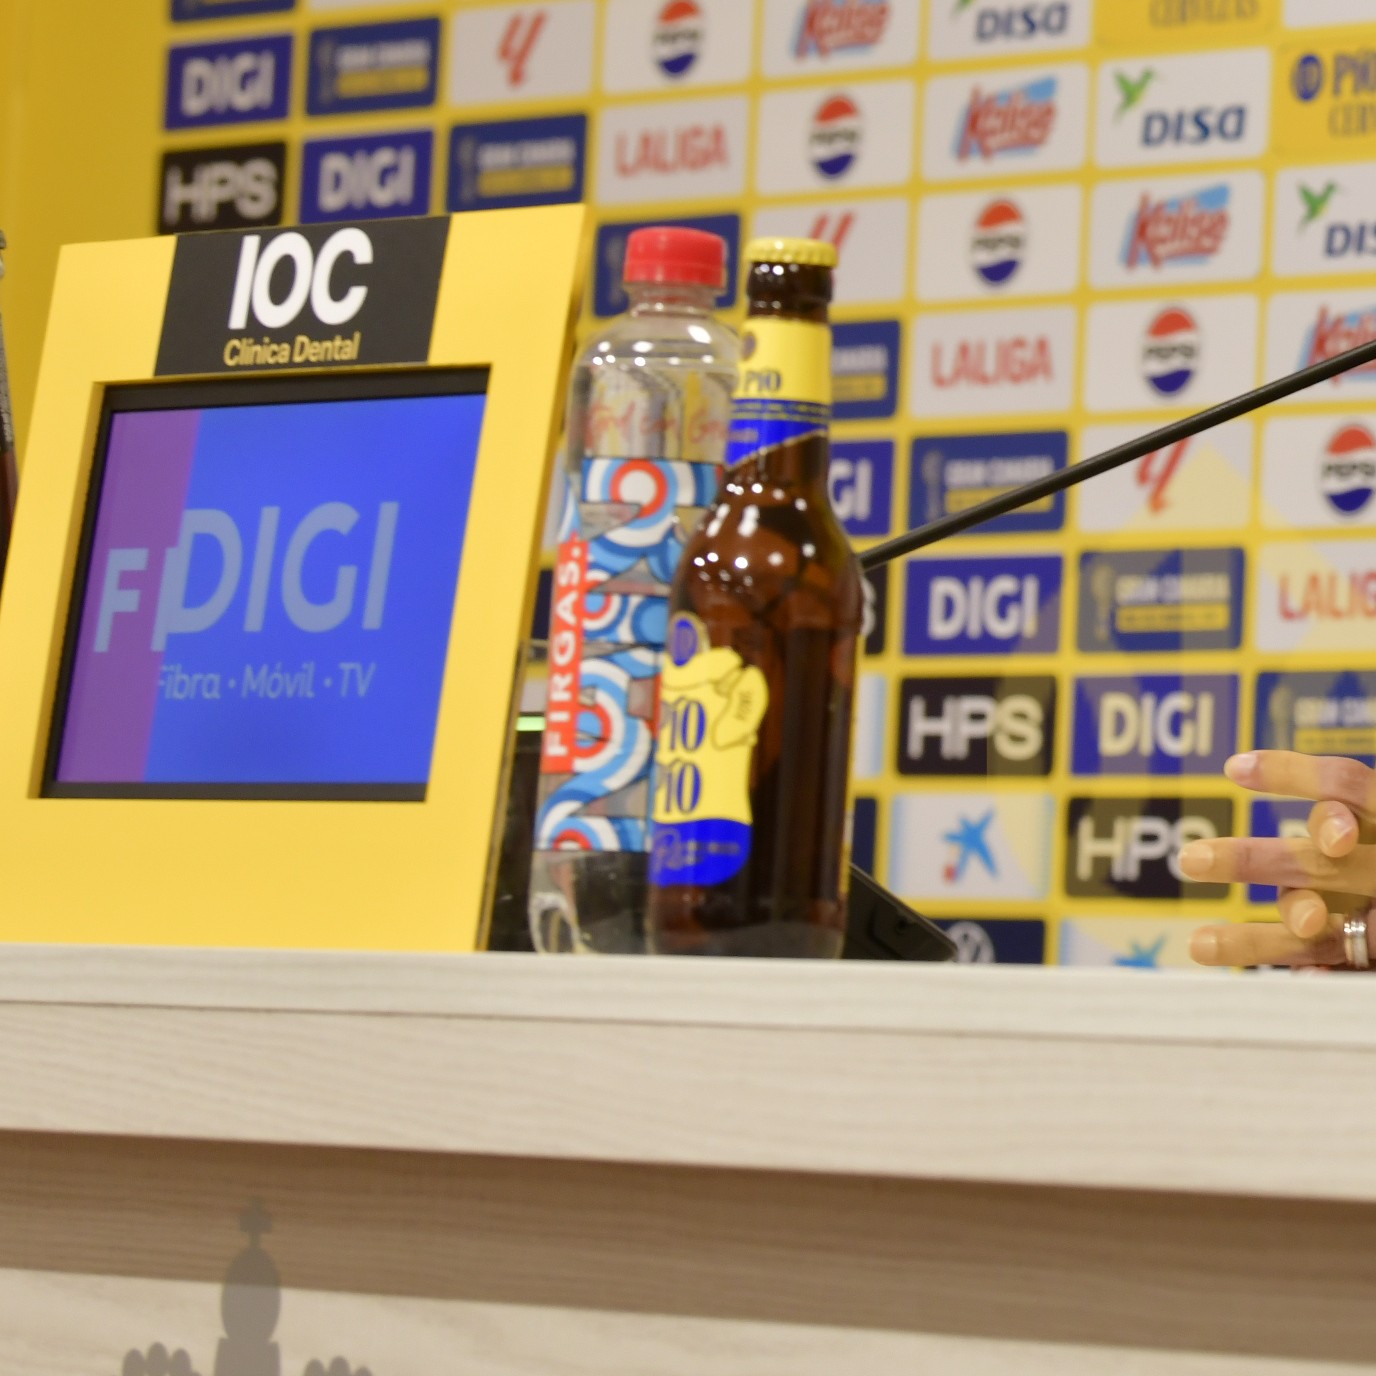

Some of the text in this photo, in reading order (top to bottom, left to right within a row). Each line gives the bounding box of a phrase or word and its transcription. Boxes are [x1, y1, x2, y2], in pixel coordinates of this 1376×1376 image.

[228, 227, 373, 330] IOC
[223, 331, 361, 367] Clínica Dental
[932, 336, 1051, 388] LALIGA
[169, 501, 399, 634] DIGI
[928, 575, 1038, 638] DIGI
[242, 661, 316, 700] Móvil
[339, 662, 377, 698] TV
[908, 696, 1040, 758] HPS
[1098, 691, 1214, 757] DIGI
